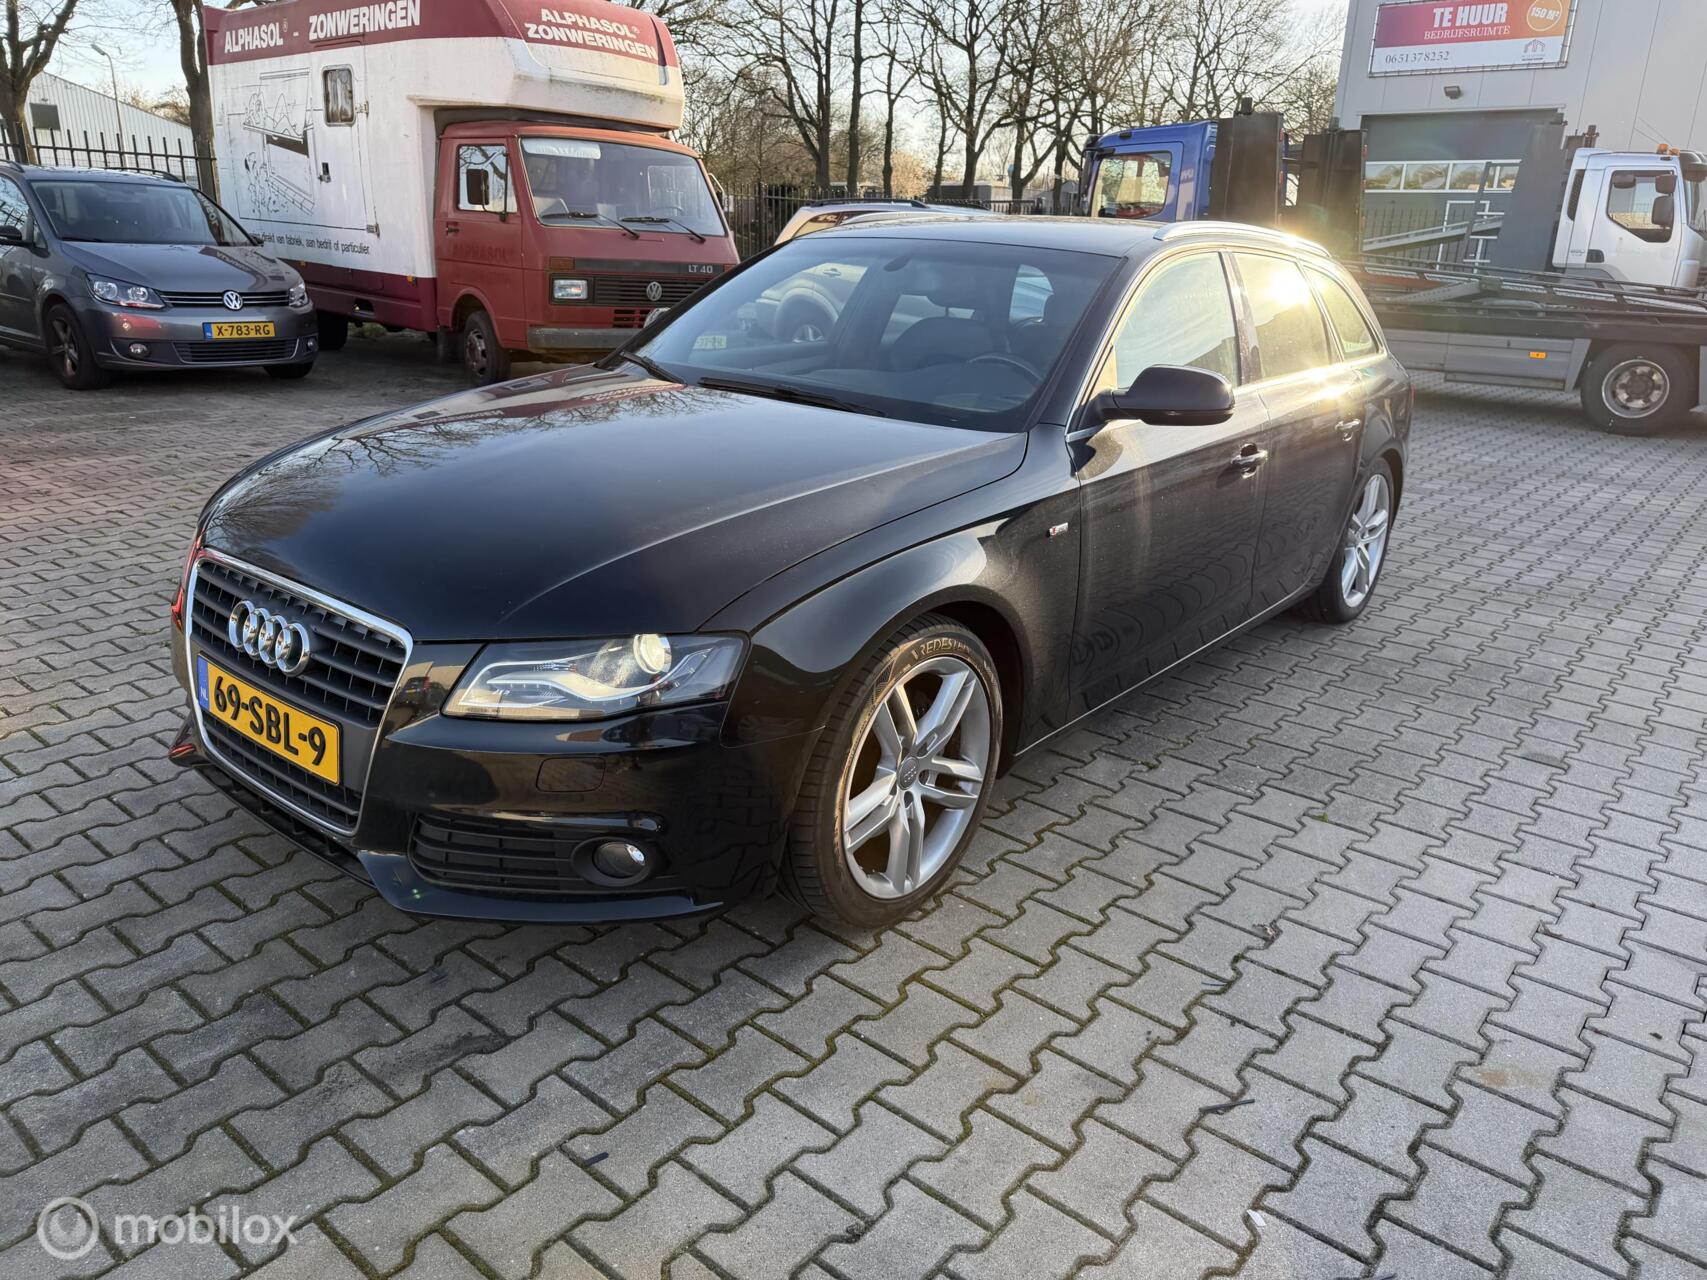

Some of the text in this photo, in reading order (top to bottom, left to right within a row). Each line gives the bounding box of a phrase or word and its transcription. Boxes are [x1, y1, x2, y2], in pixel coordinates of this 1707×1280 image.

[309, 0, 420, 41] ZONWERINGEN
[1433, 2, 1508, 28] TE HUUR
[524, 22, 659, 61] ZONWERINGEN
[1424, 25, 1510, 40] BEDRIJFSRUIMTE
[689, 264, 713, 274] LT 40
[216, 324, 270, 337] X-783-RG
[201, 686, 209, 701] NL
[214, 676, 326, 766] 69-SBL-9
